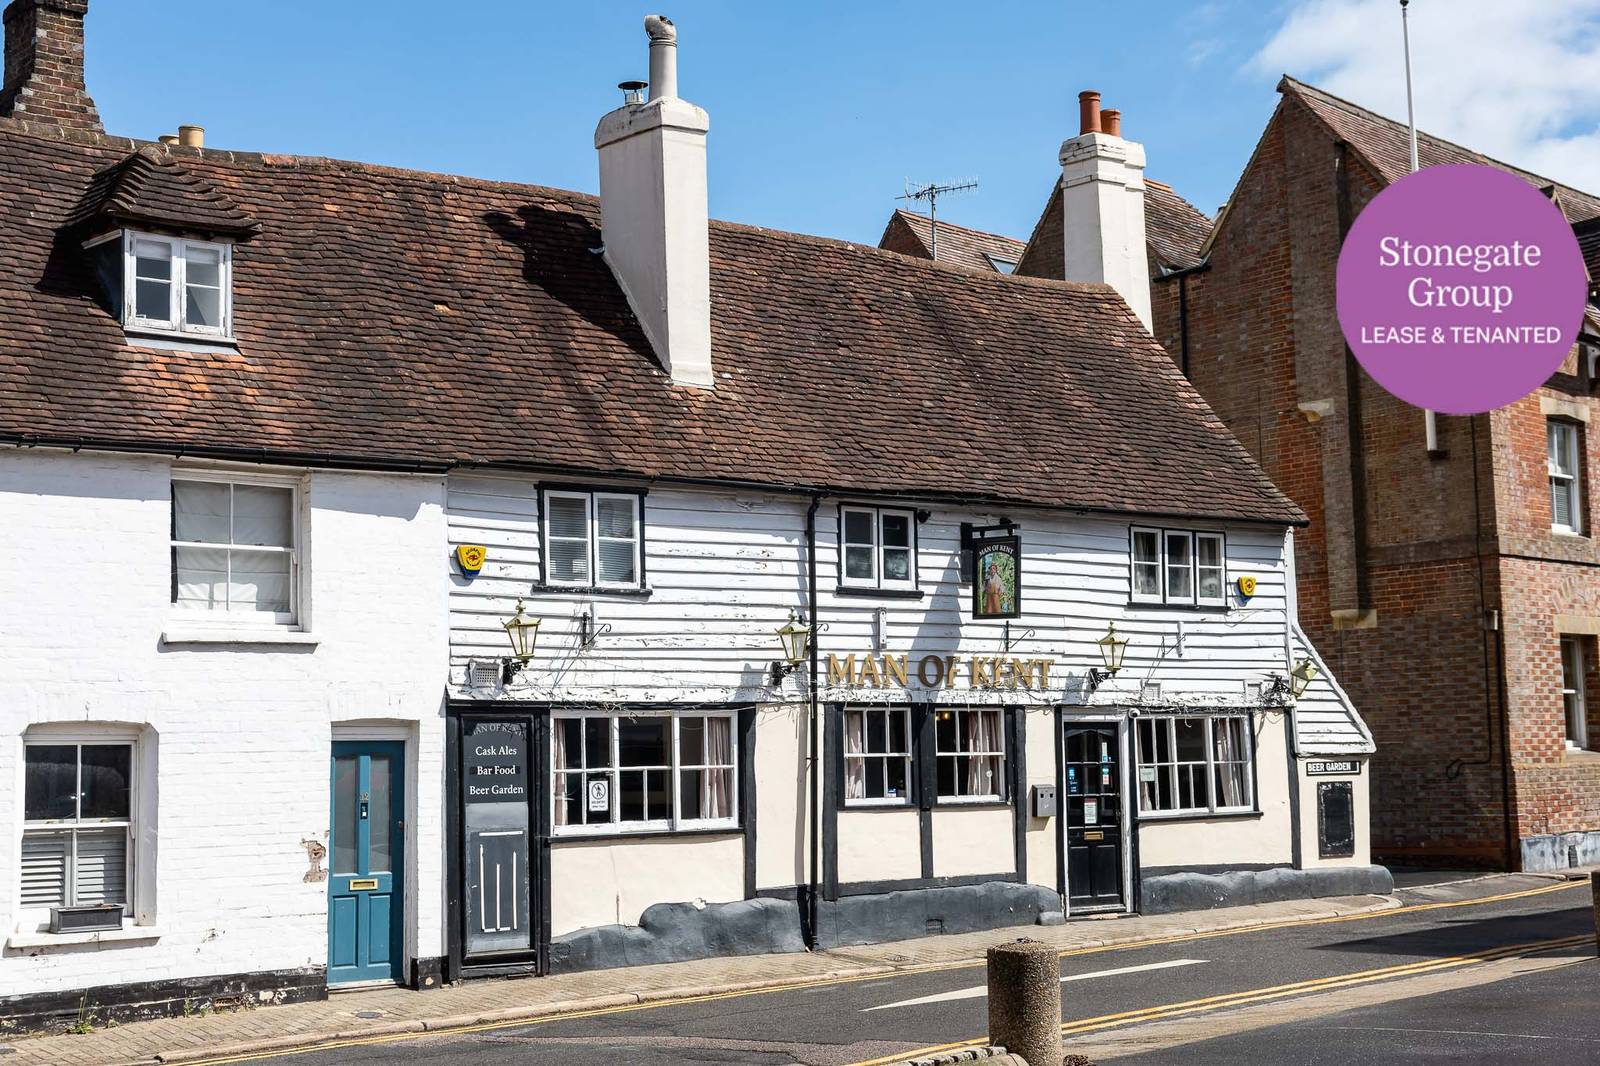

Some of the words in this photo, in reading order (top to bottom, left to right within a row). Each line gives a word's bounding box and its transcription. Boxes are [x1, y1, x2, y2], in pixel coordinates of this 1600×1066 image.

[978, 546, 992, 556] MAN
[991, 544, 999, 552] OF
[999, 545, 1014, 554] KENT
[827, 653, 909, 688] MAN
[918, 655, 961, 688] OF
[971, 656, 1056, 690] KENT
[489, 723, 501, 732] OF
[475, 745, 497, 756] Cask
[498, 745, 517, 756] Ales
[477, 766, 492, 775] Bar
[494, 765, 516, 775] Food
[1307, 763, 1325, 772] BEER
[1325, 762, 1351, 771] GARDEN
[469, 785, 490, 795] Beer
[491, 784, 524, 794] Garden
